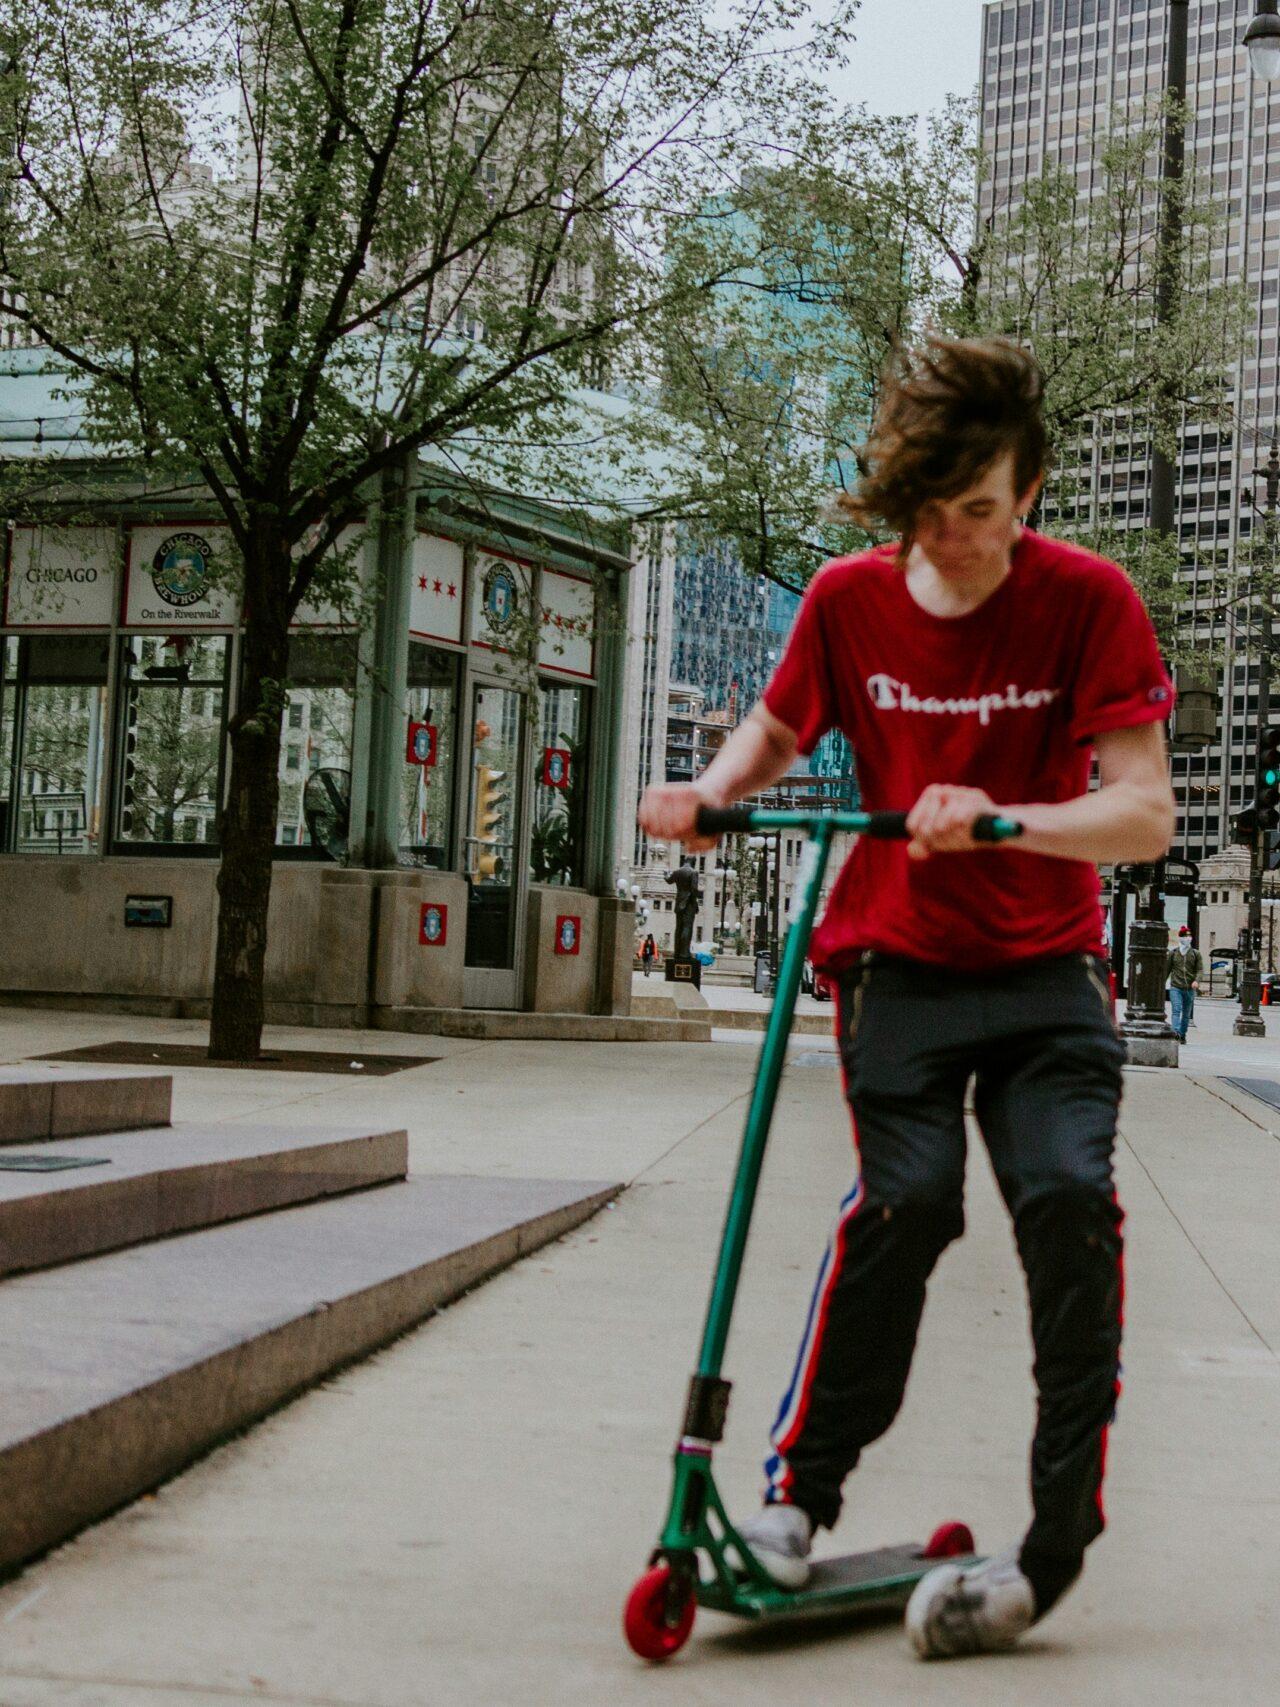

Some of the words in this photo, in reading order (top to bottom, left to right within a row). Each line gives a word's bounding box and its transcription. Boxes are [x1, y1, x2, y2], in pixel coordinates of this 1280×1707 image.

[160, 532, 211, 557] CHICAGO
[26, 567, 98, 583] CHICAGO
[141, 609, 155, 619] On
[158, 609, 172, 619] the
[174, 609, 221, 619] Riverwalk
